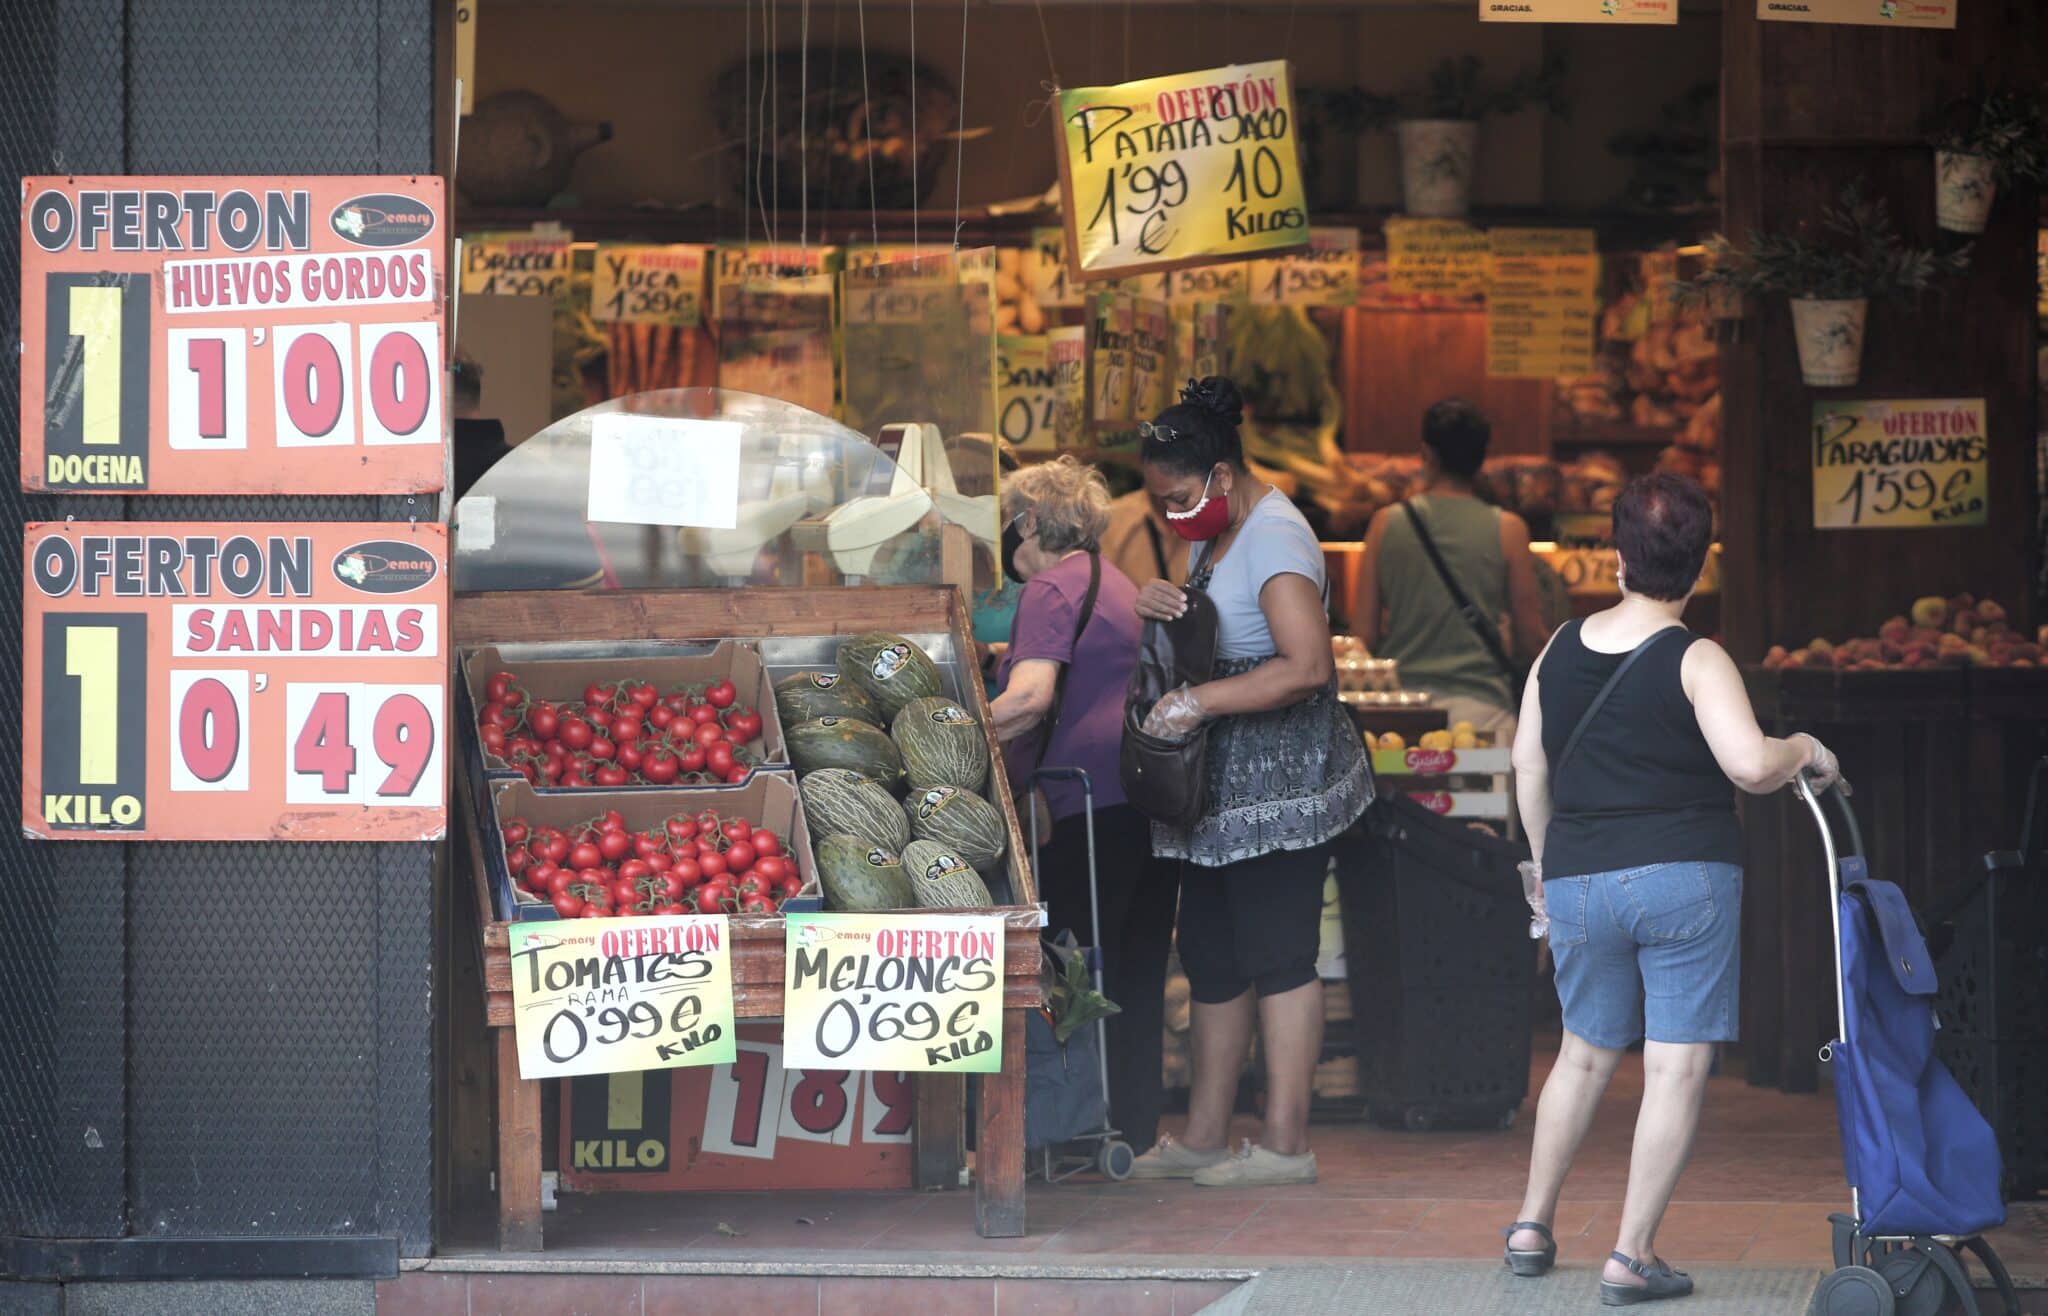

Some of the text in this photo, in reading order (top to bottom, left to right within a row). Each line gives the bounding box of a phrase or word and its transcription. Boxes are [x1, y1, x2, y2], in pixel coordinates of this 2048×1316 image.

[1223, 146, 1283, 202] 10
[29, 188, 311, 252] OFERTON
[1087, 160, 1188, 245] 1'99
[1227, 206, 1304, 241] KILOS
[171, 254, 427, 308] HUEVOS GORDOS
[607, 254, 680, 290] YUCA
[69, 286, 123, 444] 1
[48, 455, 144, 485] DOCENA
[32, 535, 312, 598] OFERTON
[186, 608, 425, 652] SANDIAS
[66, 626, 118, 784] 1
[178, 673, 435, 798] 0'49
[45, 795, 142, 825] KILO
[601, 919, 720, 959] OFERTÓN
[877, 925, 995, 960] OFERTÓN
[512, 943, 713, 993] TOMATES
[793, 947, 996, 994] MELONES
[568, 986, 630, 1006] RAMA
[925, 1030, 993, 1066] KILO
[574, 1139, 666, 1167] KILO
